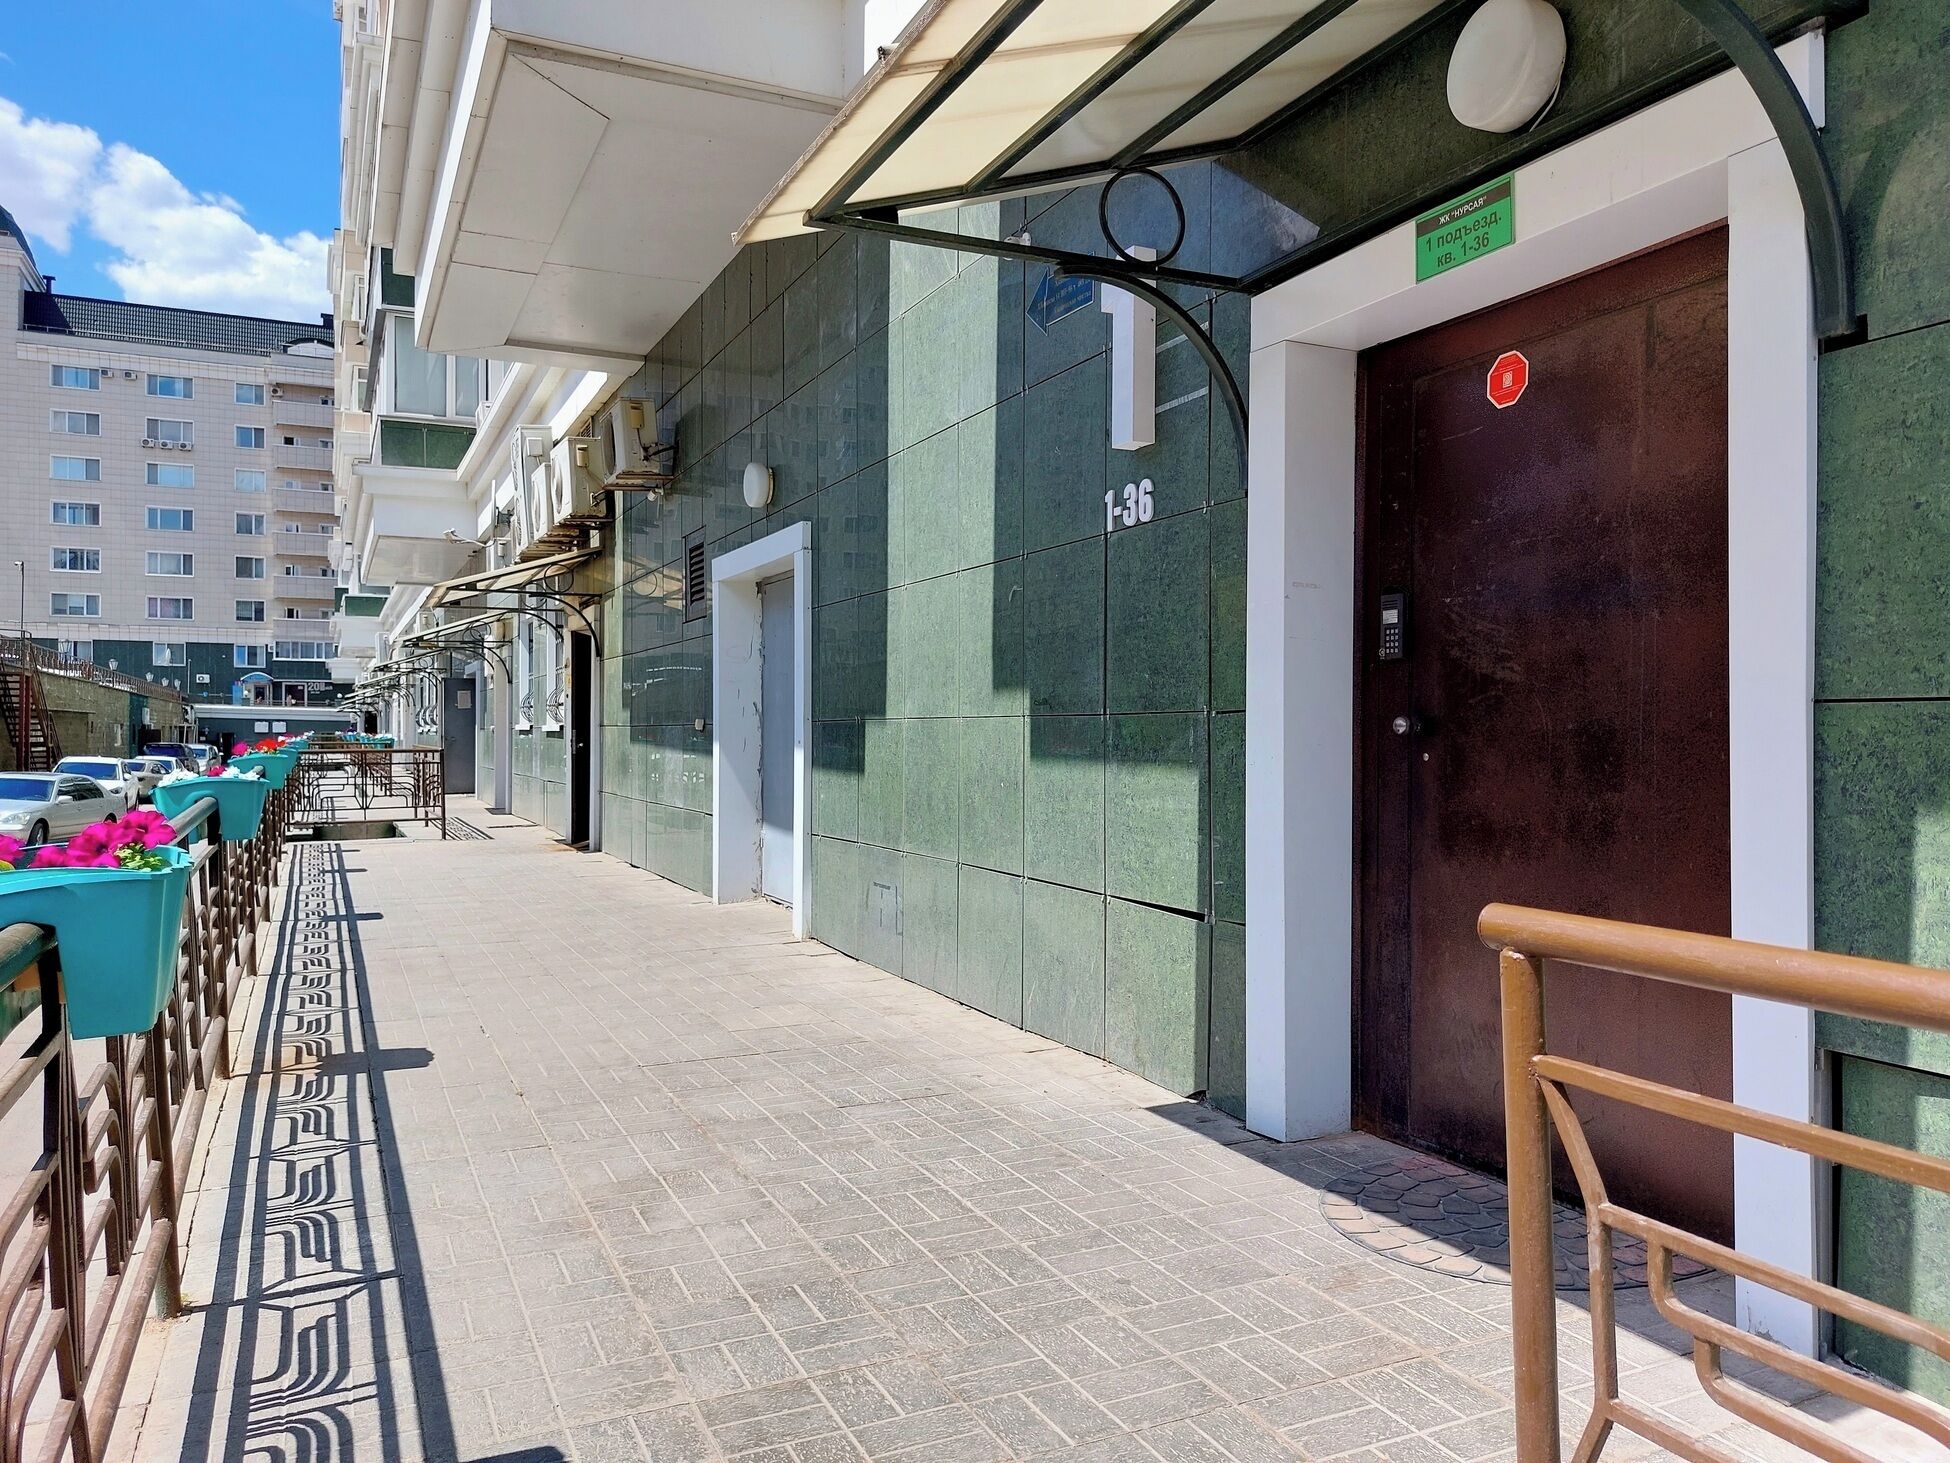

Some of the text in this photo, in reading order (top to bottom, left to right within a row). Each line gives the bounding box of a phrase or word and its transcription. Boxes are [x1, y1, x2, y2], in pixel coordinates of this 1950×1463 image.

[1426, 211, 1502, 253] 1 подъезд.
[1438, 213, 1450, 226] ЖК
[1437, 231, 1490, 268] кв. 1-36
[1104, 478, 1155, 532] 1-36
